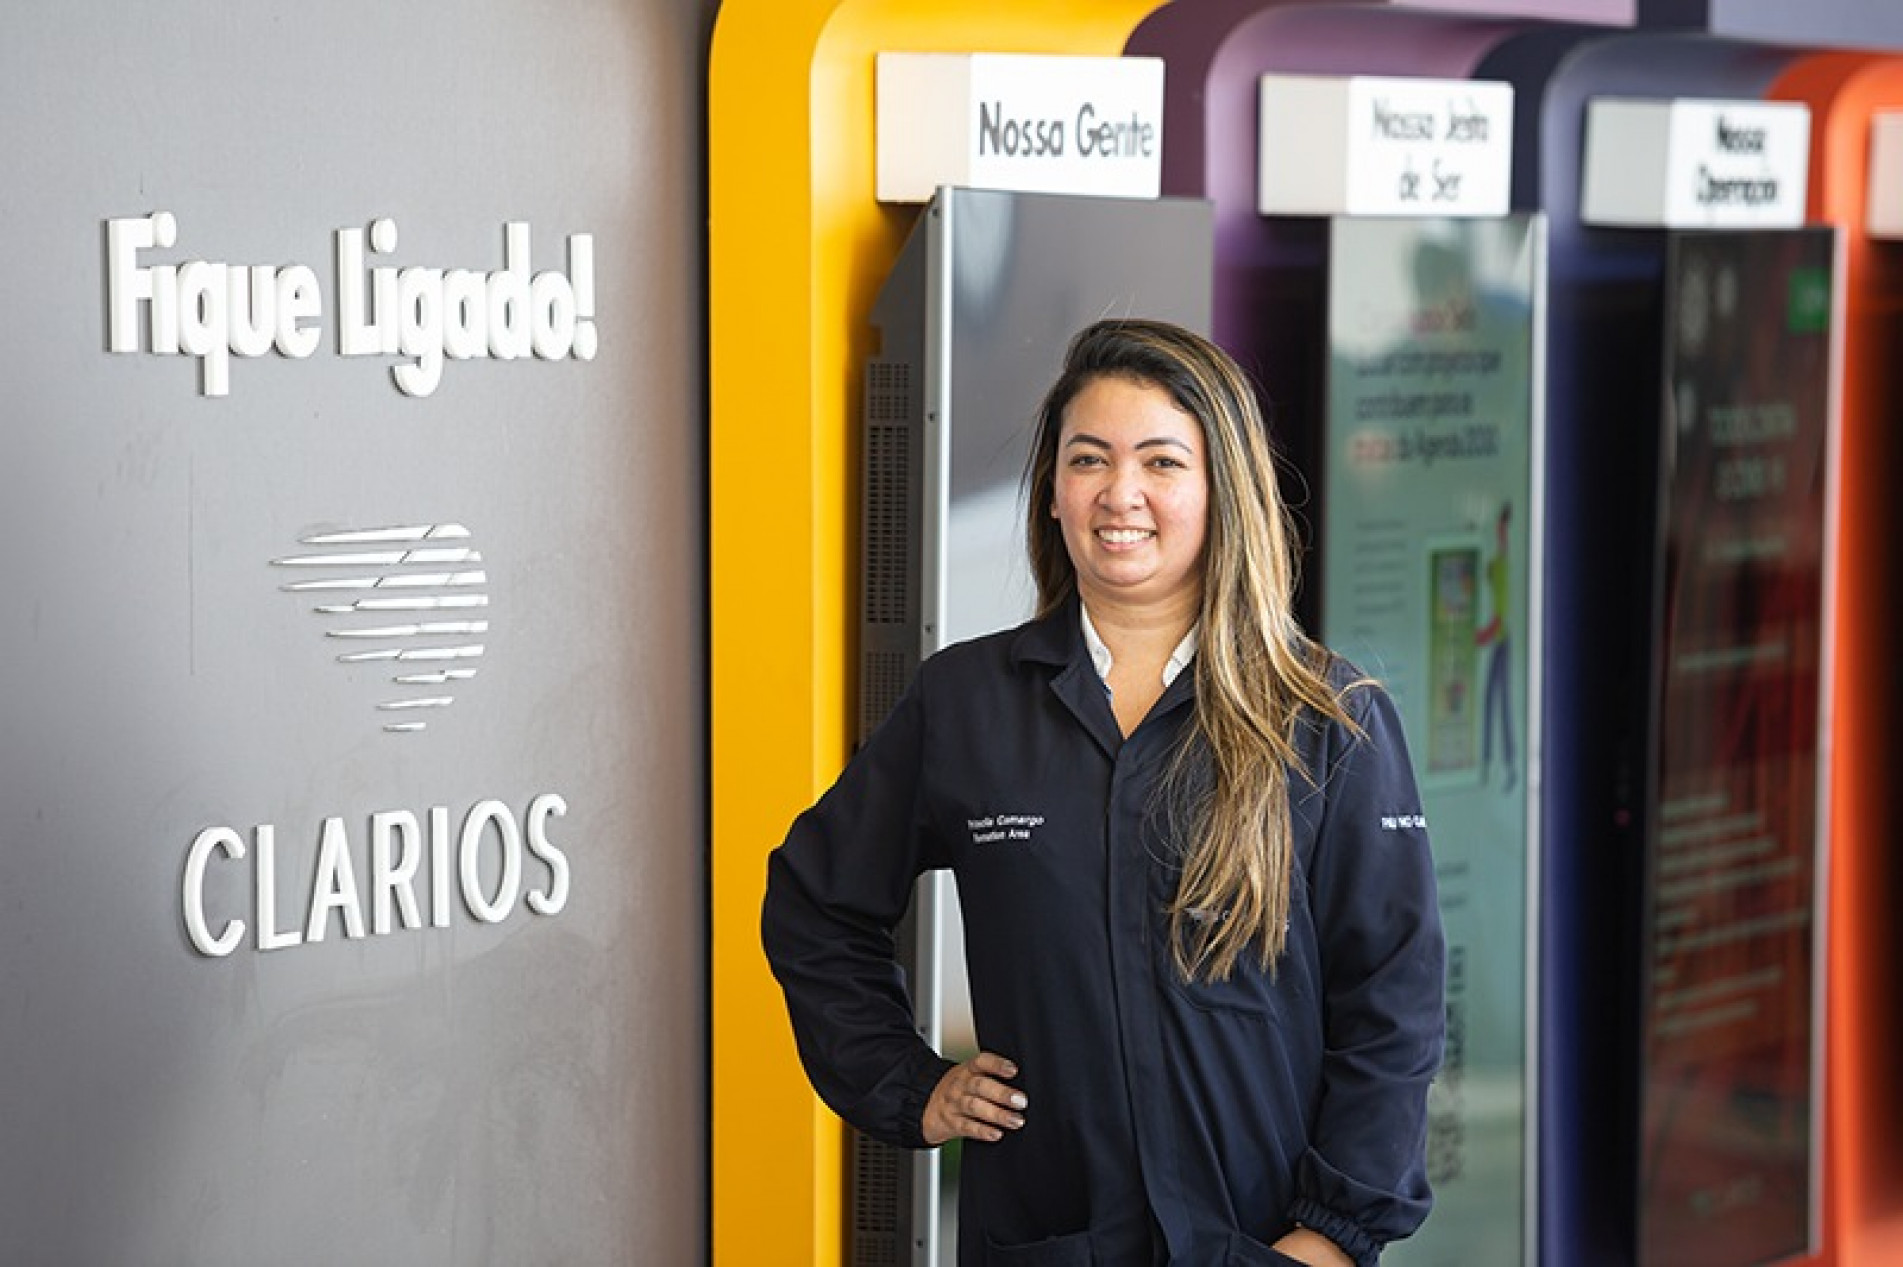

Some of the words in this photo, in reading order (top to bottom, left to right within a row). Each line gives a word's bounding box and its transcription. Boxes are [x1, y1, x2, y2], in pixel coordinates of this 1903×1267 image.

[979, 101, 1064, 156] Nossa
[1076, 102, 1153, 157] Gente
[1399, 153, 1419, 201] de
[103, 211, 321, 396] Fique
[335, 217, 597, 397] Ligado!
[182, 794, 569, 957] CLARIOS
